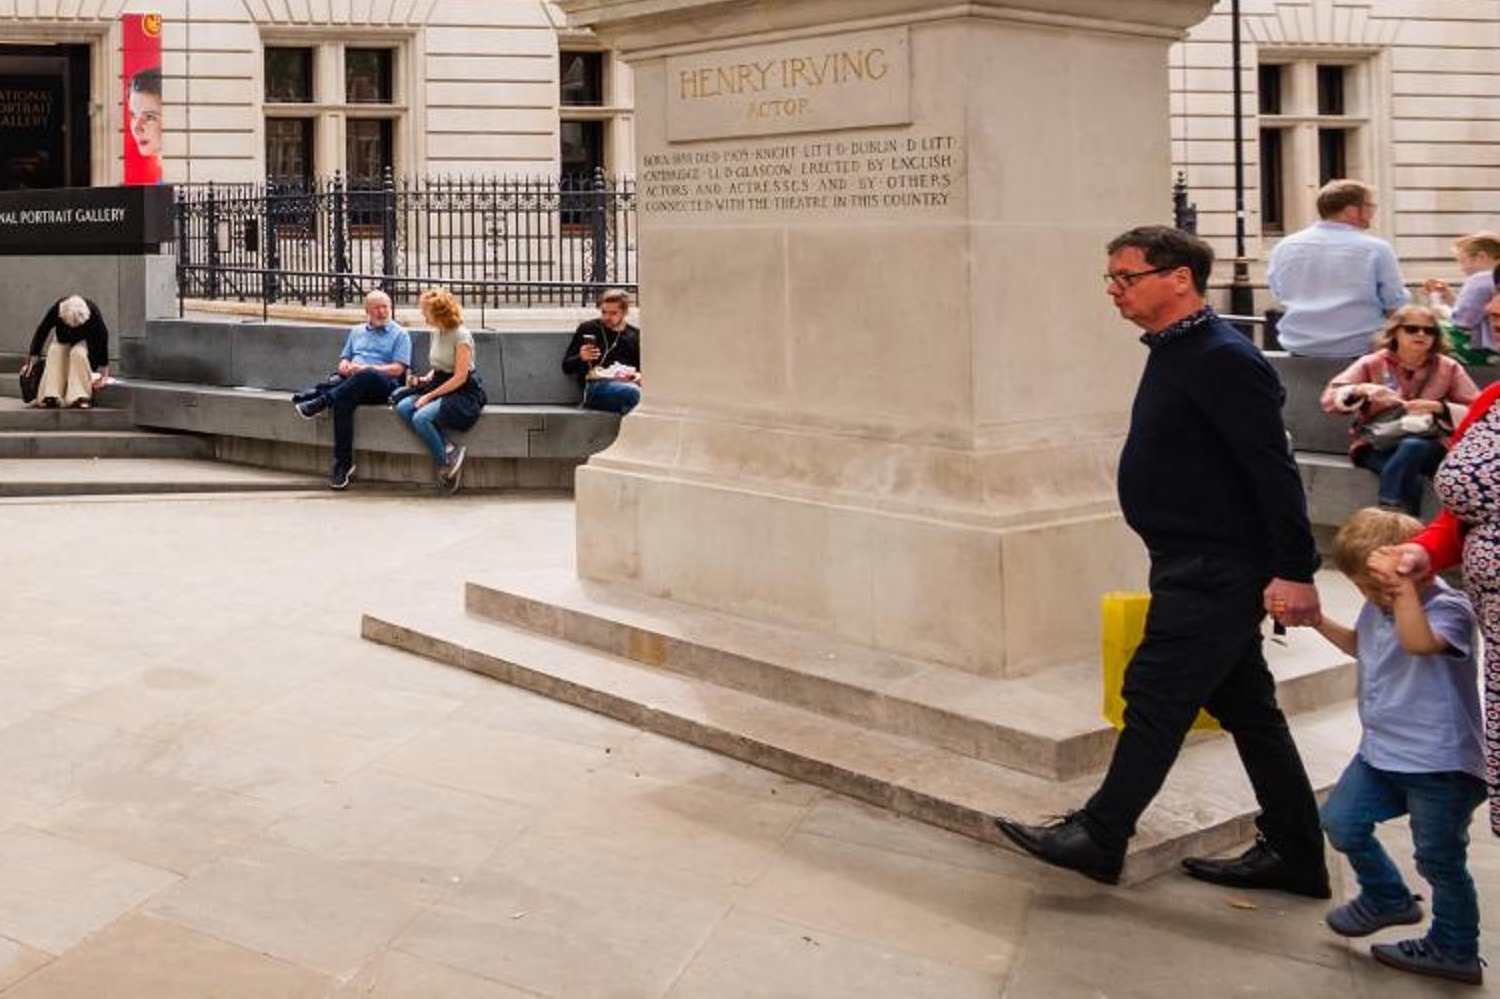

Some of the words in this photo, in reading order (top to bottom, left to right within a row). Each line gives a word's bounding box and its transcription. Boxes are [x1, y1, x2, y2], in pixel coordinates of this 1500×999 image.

[679, 60, 773, 99] HENRY
[781, 49, 888, 89] IRVING
[748, 98, 810, 119] ACTOR
[851, 139, 897, 154] DUBLIN
[801, 160, 861, 175] ERECTED
[867, 158, 885, 171] BY
[891, 154, 951, 170] ENGLISH
[645, 184, 689, 197] ACTORS
[696, 183, 723, 195] AND
[729, 179, 809, 194] ACTRESSES
[820, 178, 847, 191] AND
[887, 174, 951, 189] OTHERS
[645, 199, 712, 212] CONNECTED
[715, 198, 745, 211] WITH
[748, 198, 767, 210] THE
[774, 196, 829, 210] THEATRE
[833, 195, 847, 208] IN
[851, 194, 879, 208] THIS
[883, 192, 949, 207] COUNTRY
[20, 209, 72, 224] PORTRAIT
[75, 208, 125, 223] GALLERY
